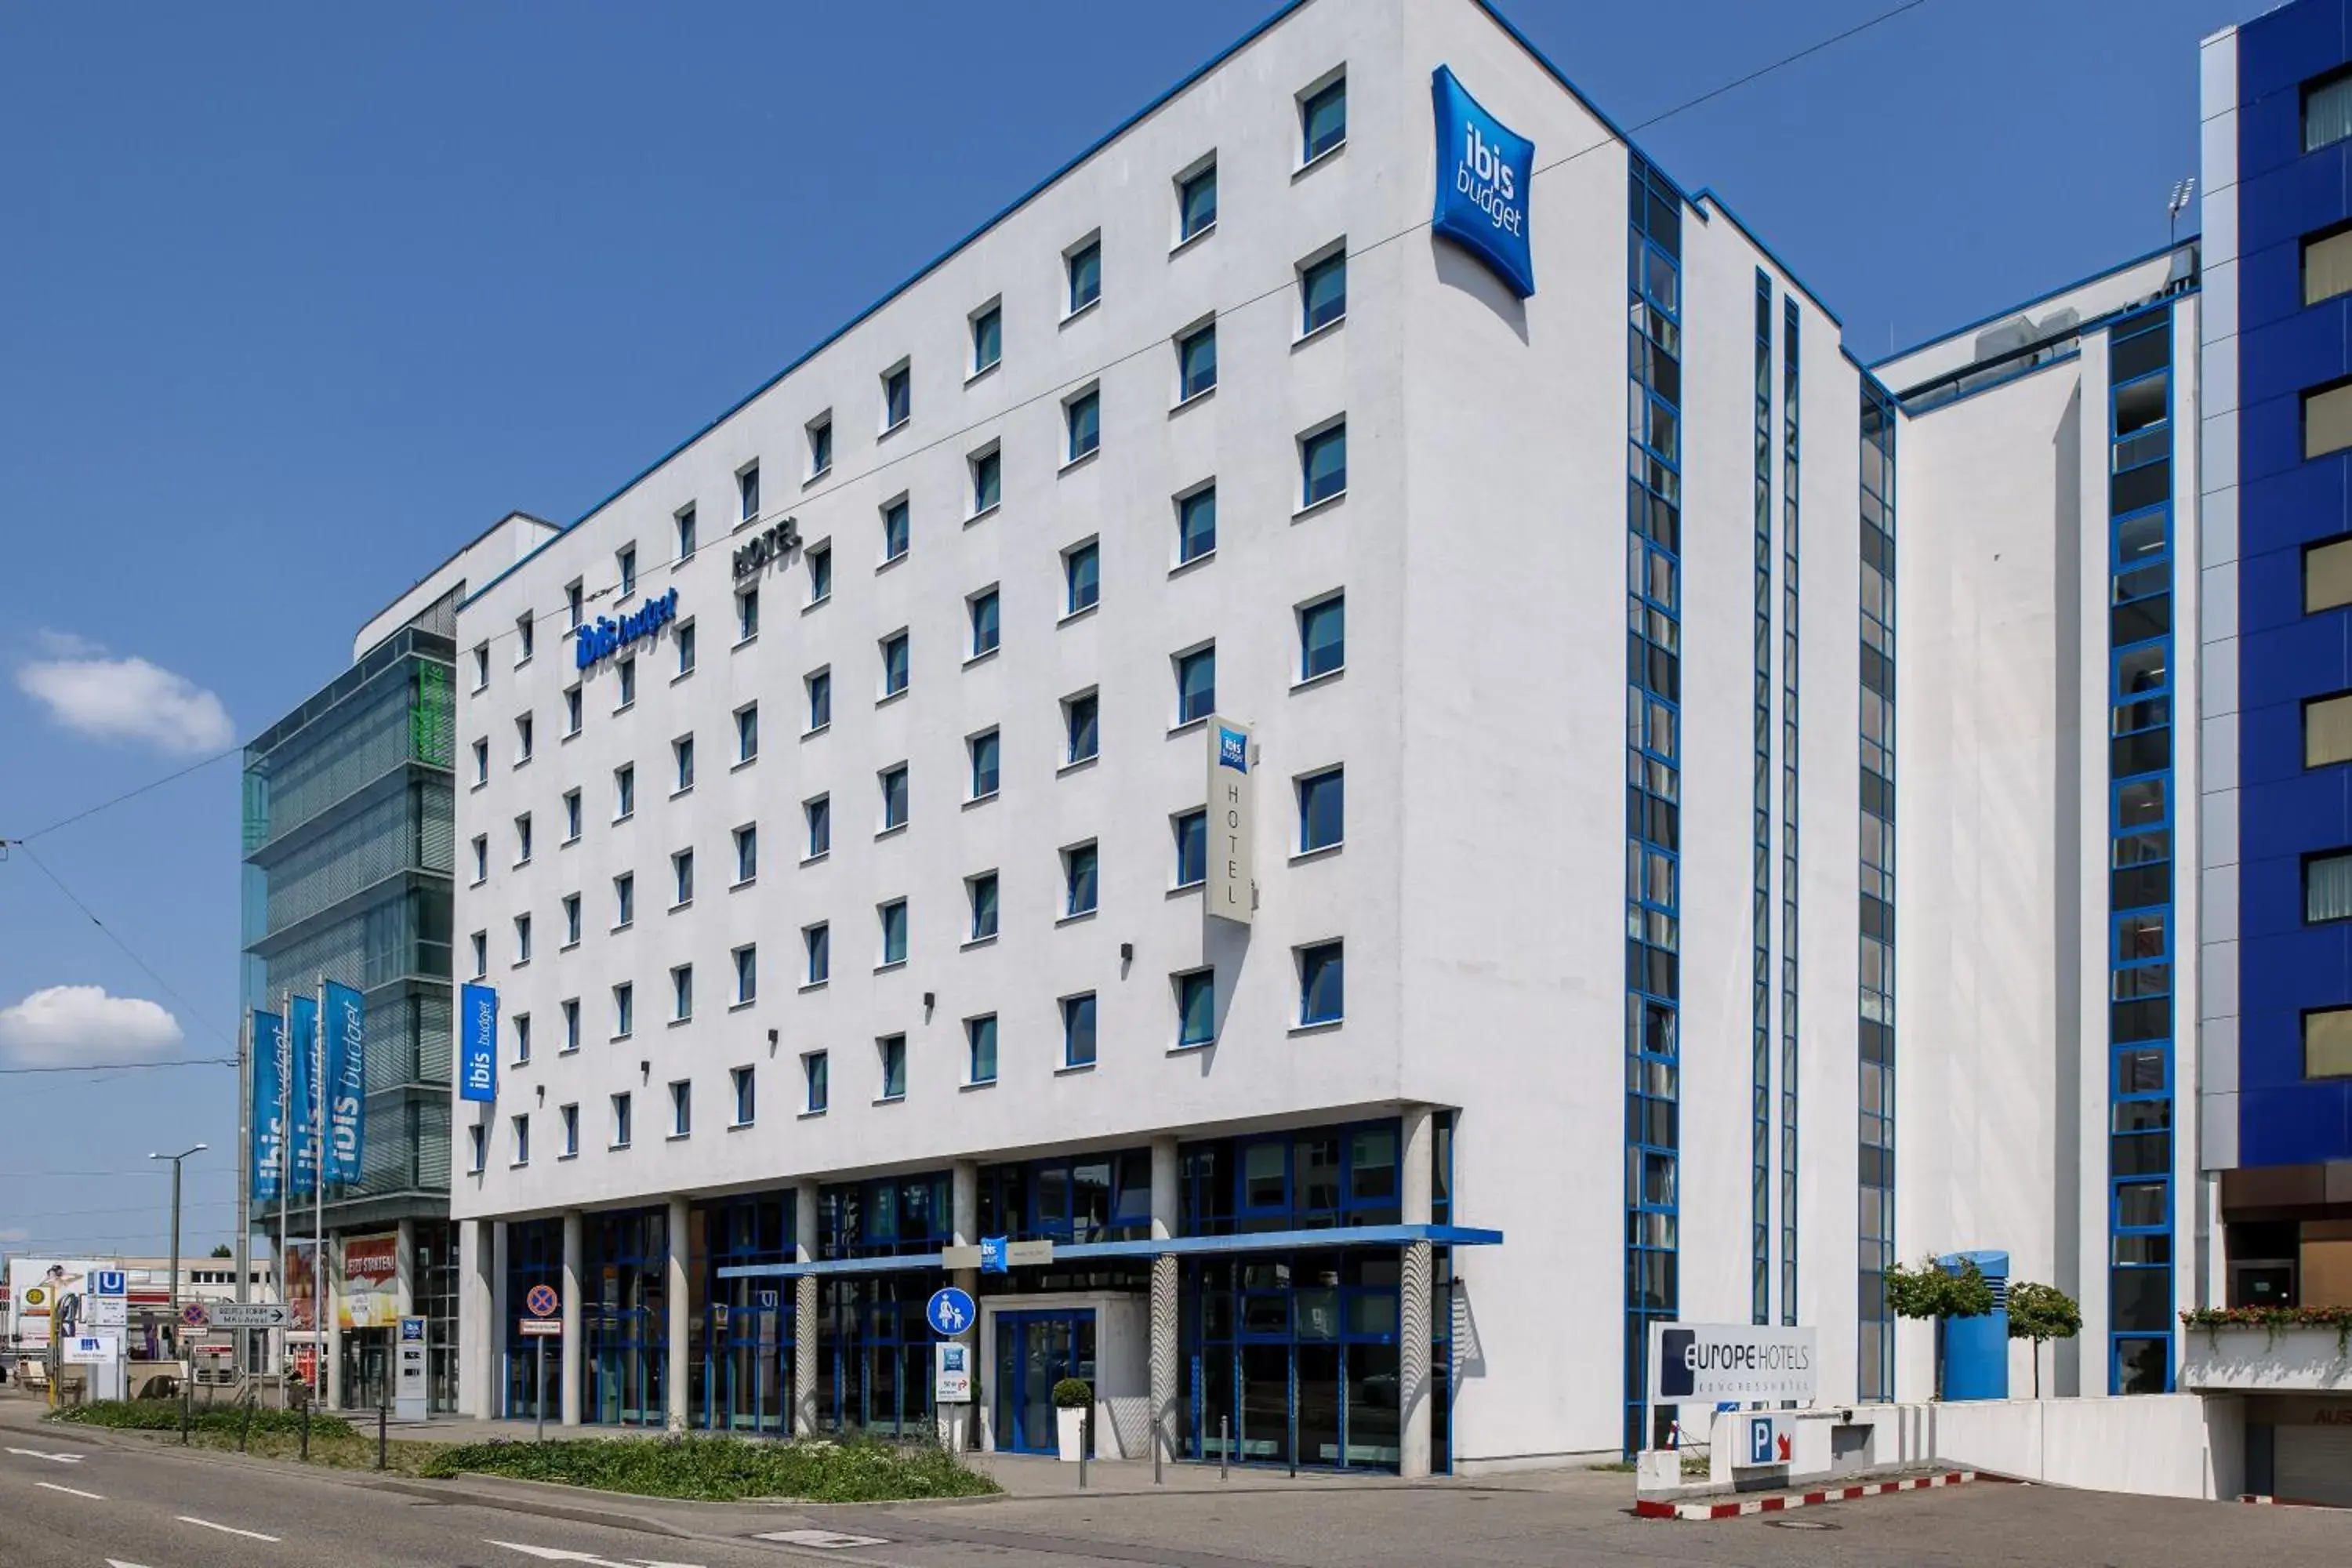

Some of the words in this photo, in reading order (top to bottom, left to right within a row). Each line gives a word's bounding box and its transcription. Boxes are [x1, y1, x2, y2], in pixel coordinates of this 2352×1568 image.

[1467, 121, 1514, 200] ibis
[1457, 160, 1521, 237] budget
[1225, 739, 1241, 753] ibis
[1228, 784, 1238, 904] HOTEL
[477, 1000, 494, 1047] budget
[469, 1053, 490, 1089] ibis
[103, 1272, 121, 1289] U
[1755, 1423, 1769, 1460] P
